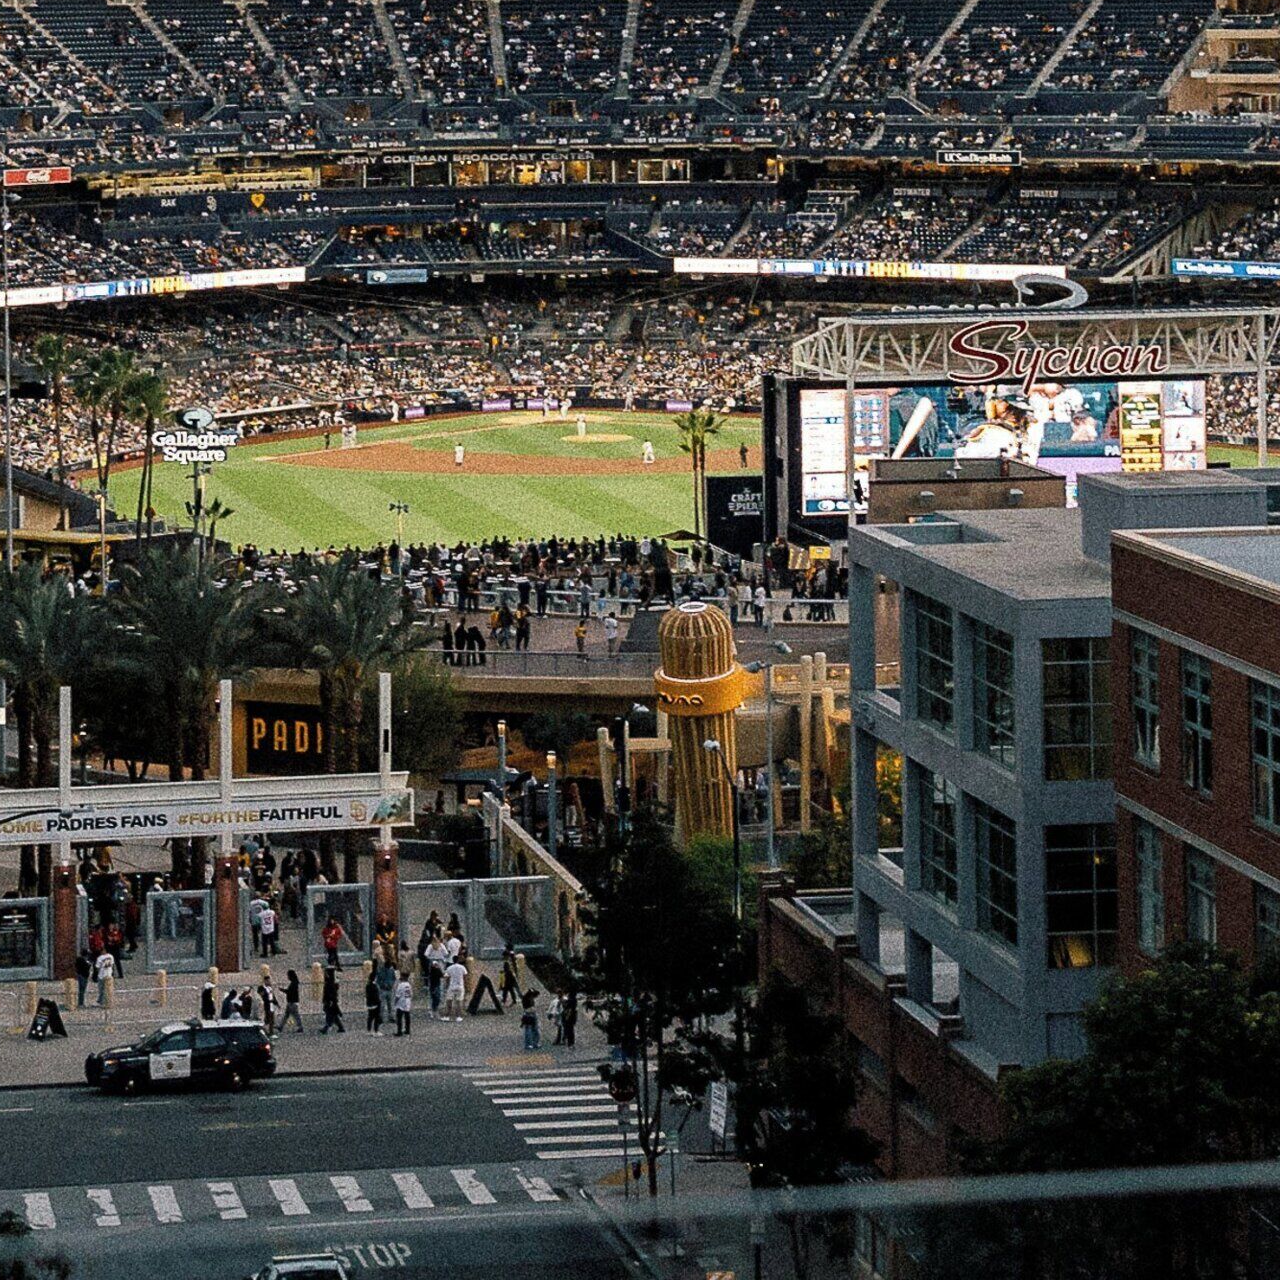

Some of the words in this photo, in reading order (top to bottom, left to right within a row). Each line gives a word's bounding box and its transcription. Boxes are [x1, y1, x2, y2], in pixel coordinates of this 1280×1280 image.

[337, 156, 377, 165] JERRY
[383, 155, 447, 163] COLEMAN
[453, 153, 536, 162] BROADCAST
[542, 152, 595, 160] CENTER
[948, 320, 1168, 396] Sycuan
[151, 431, 237, 450] Gallagher
[163, 447, 226, 465] Square
[731, 493, 762, 502] CRAFT
[46, 815, 119, 832] PADRES
[121, 813, 168, 828] FANS
[324, 1242, 412, 1268] STOP
